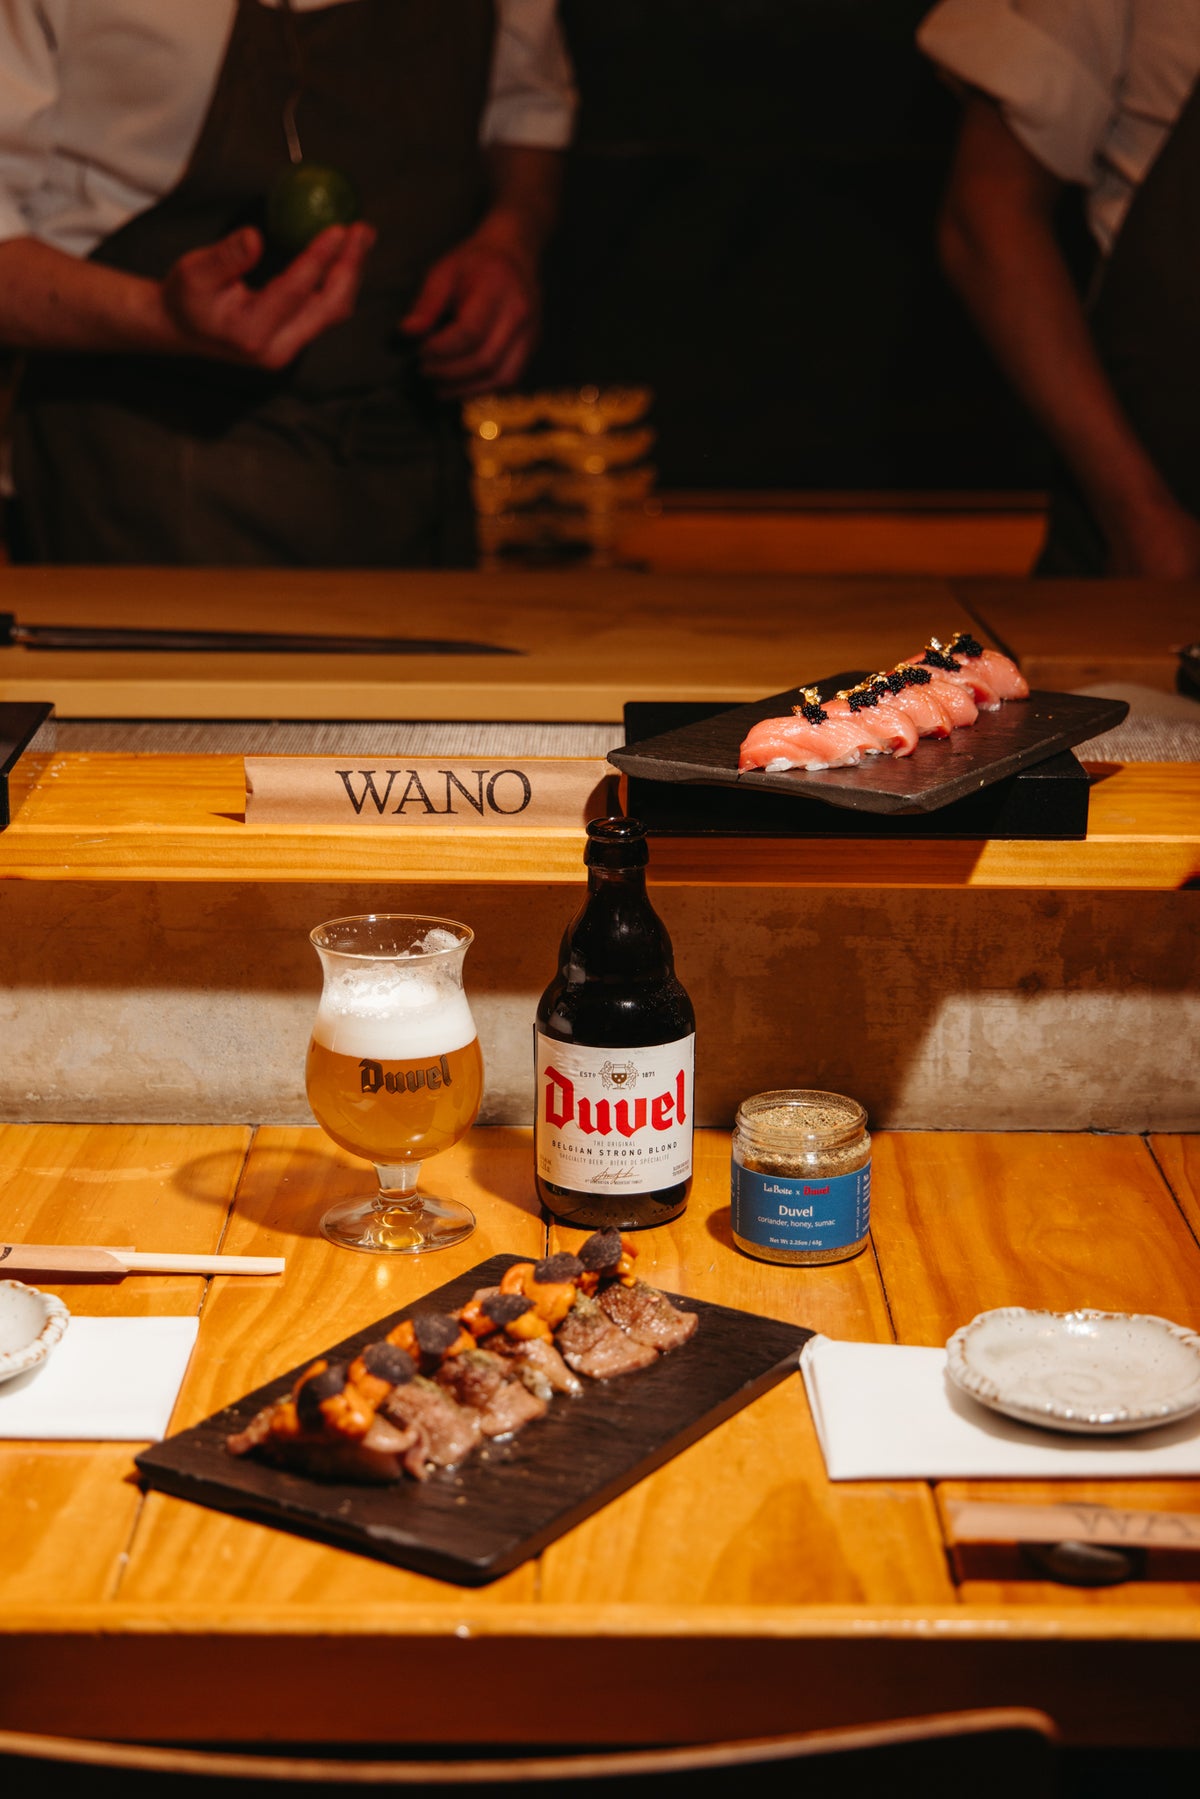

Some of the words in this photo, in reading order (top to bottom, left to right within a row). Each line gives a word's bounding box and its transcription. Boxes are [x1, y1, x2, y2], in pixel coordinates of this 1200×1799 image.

[334, 769, 532, 817] WANO
[358, 1054, 453, 1095] Duvel
[642, 1070, 655, 1078] 1871
[544, 1065, 686, 1138] Duvel
[551, 1139, 593, 1155] BELGIAN
[599, 1149, 642, 1157] STRONG
[648, 1141, 678, 1155] BLOND
[559, 1152, 586, 1164] SPECIALTY
[763, 1183, 773, 1192] La
[803, 1185, 830, 1196] Duvel
[778, 1205, 813, 1217] Duvel
[757, 1216, 789, 1227] coriander,
[790, 1219, 814, 1229] honey,
[814, 1219, 836, 1228] sumac
